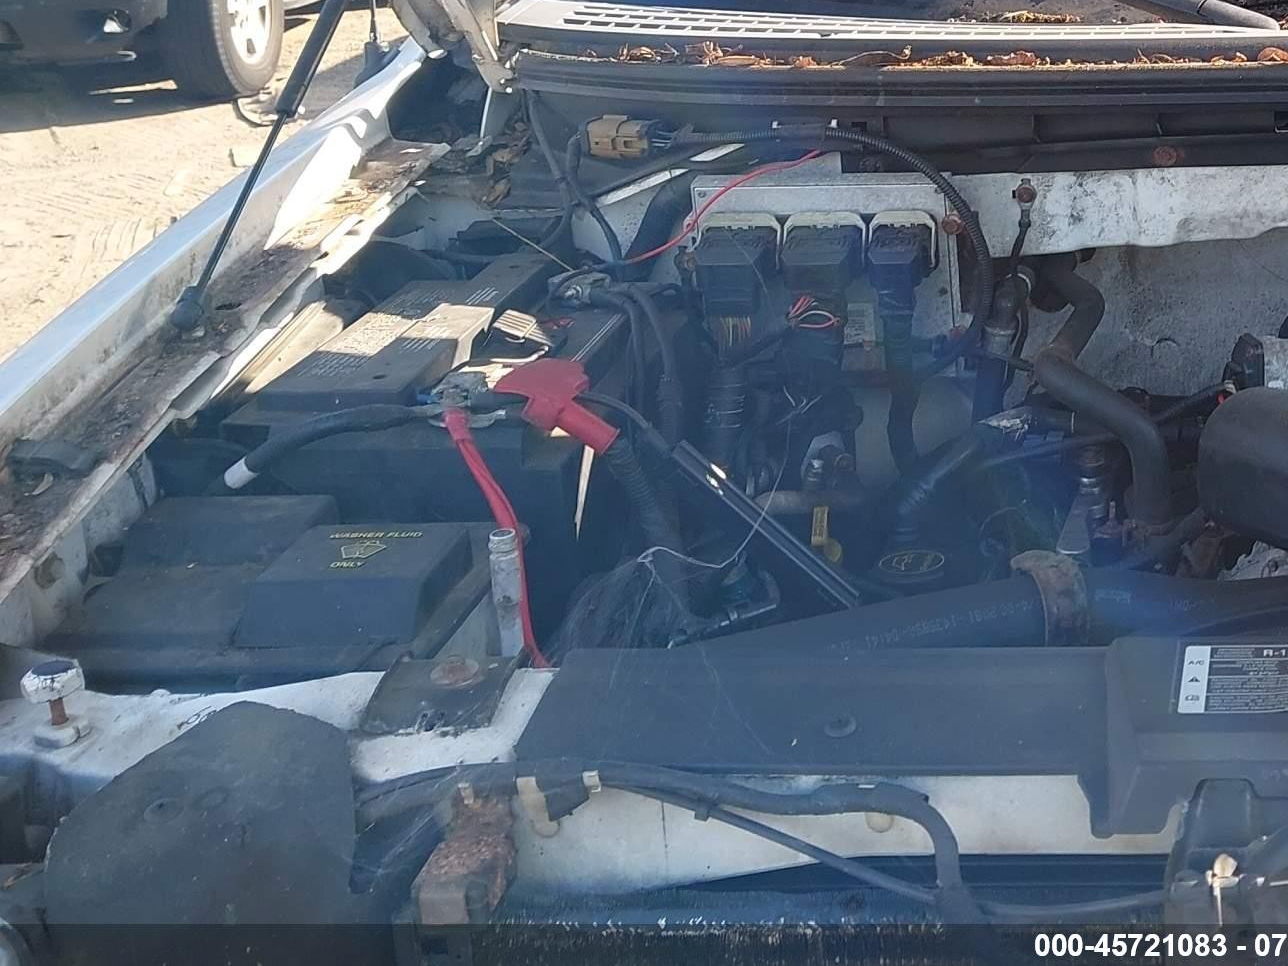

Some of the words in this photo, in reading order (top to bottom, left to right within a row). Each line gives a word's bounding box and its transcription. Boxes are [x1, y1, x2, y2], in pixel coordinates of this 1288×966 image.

[329, 530, 385, 539] WASHER
[386, 530, 423, 538] FLUID
[330, 561, 366, 569] ONLY
